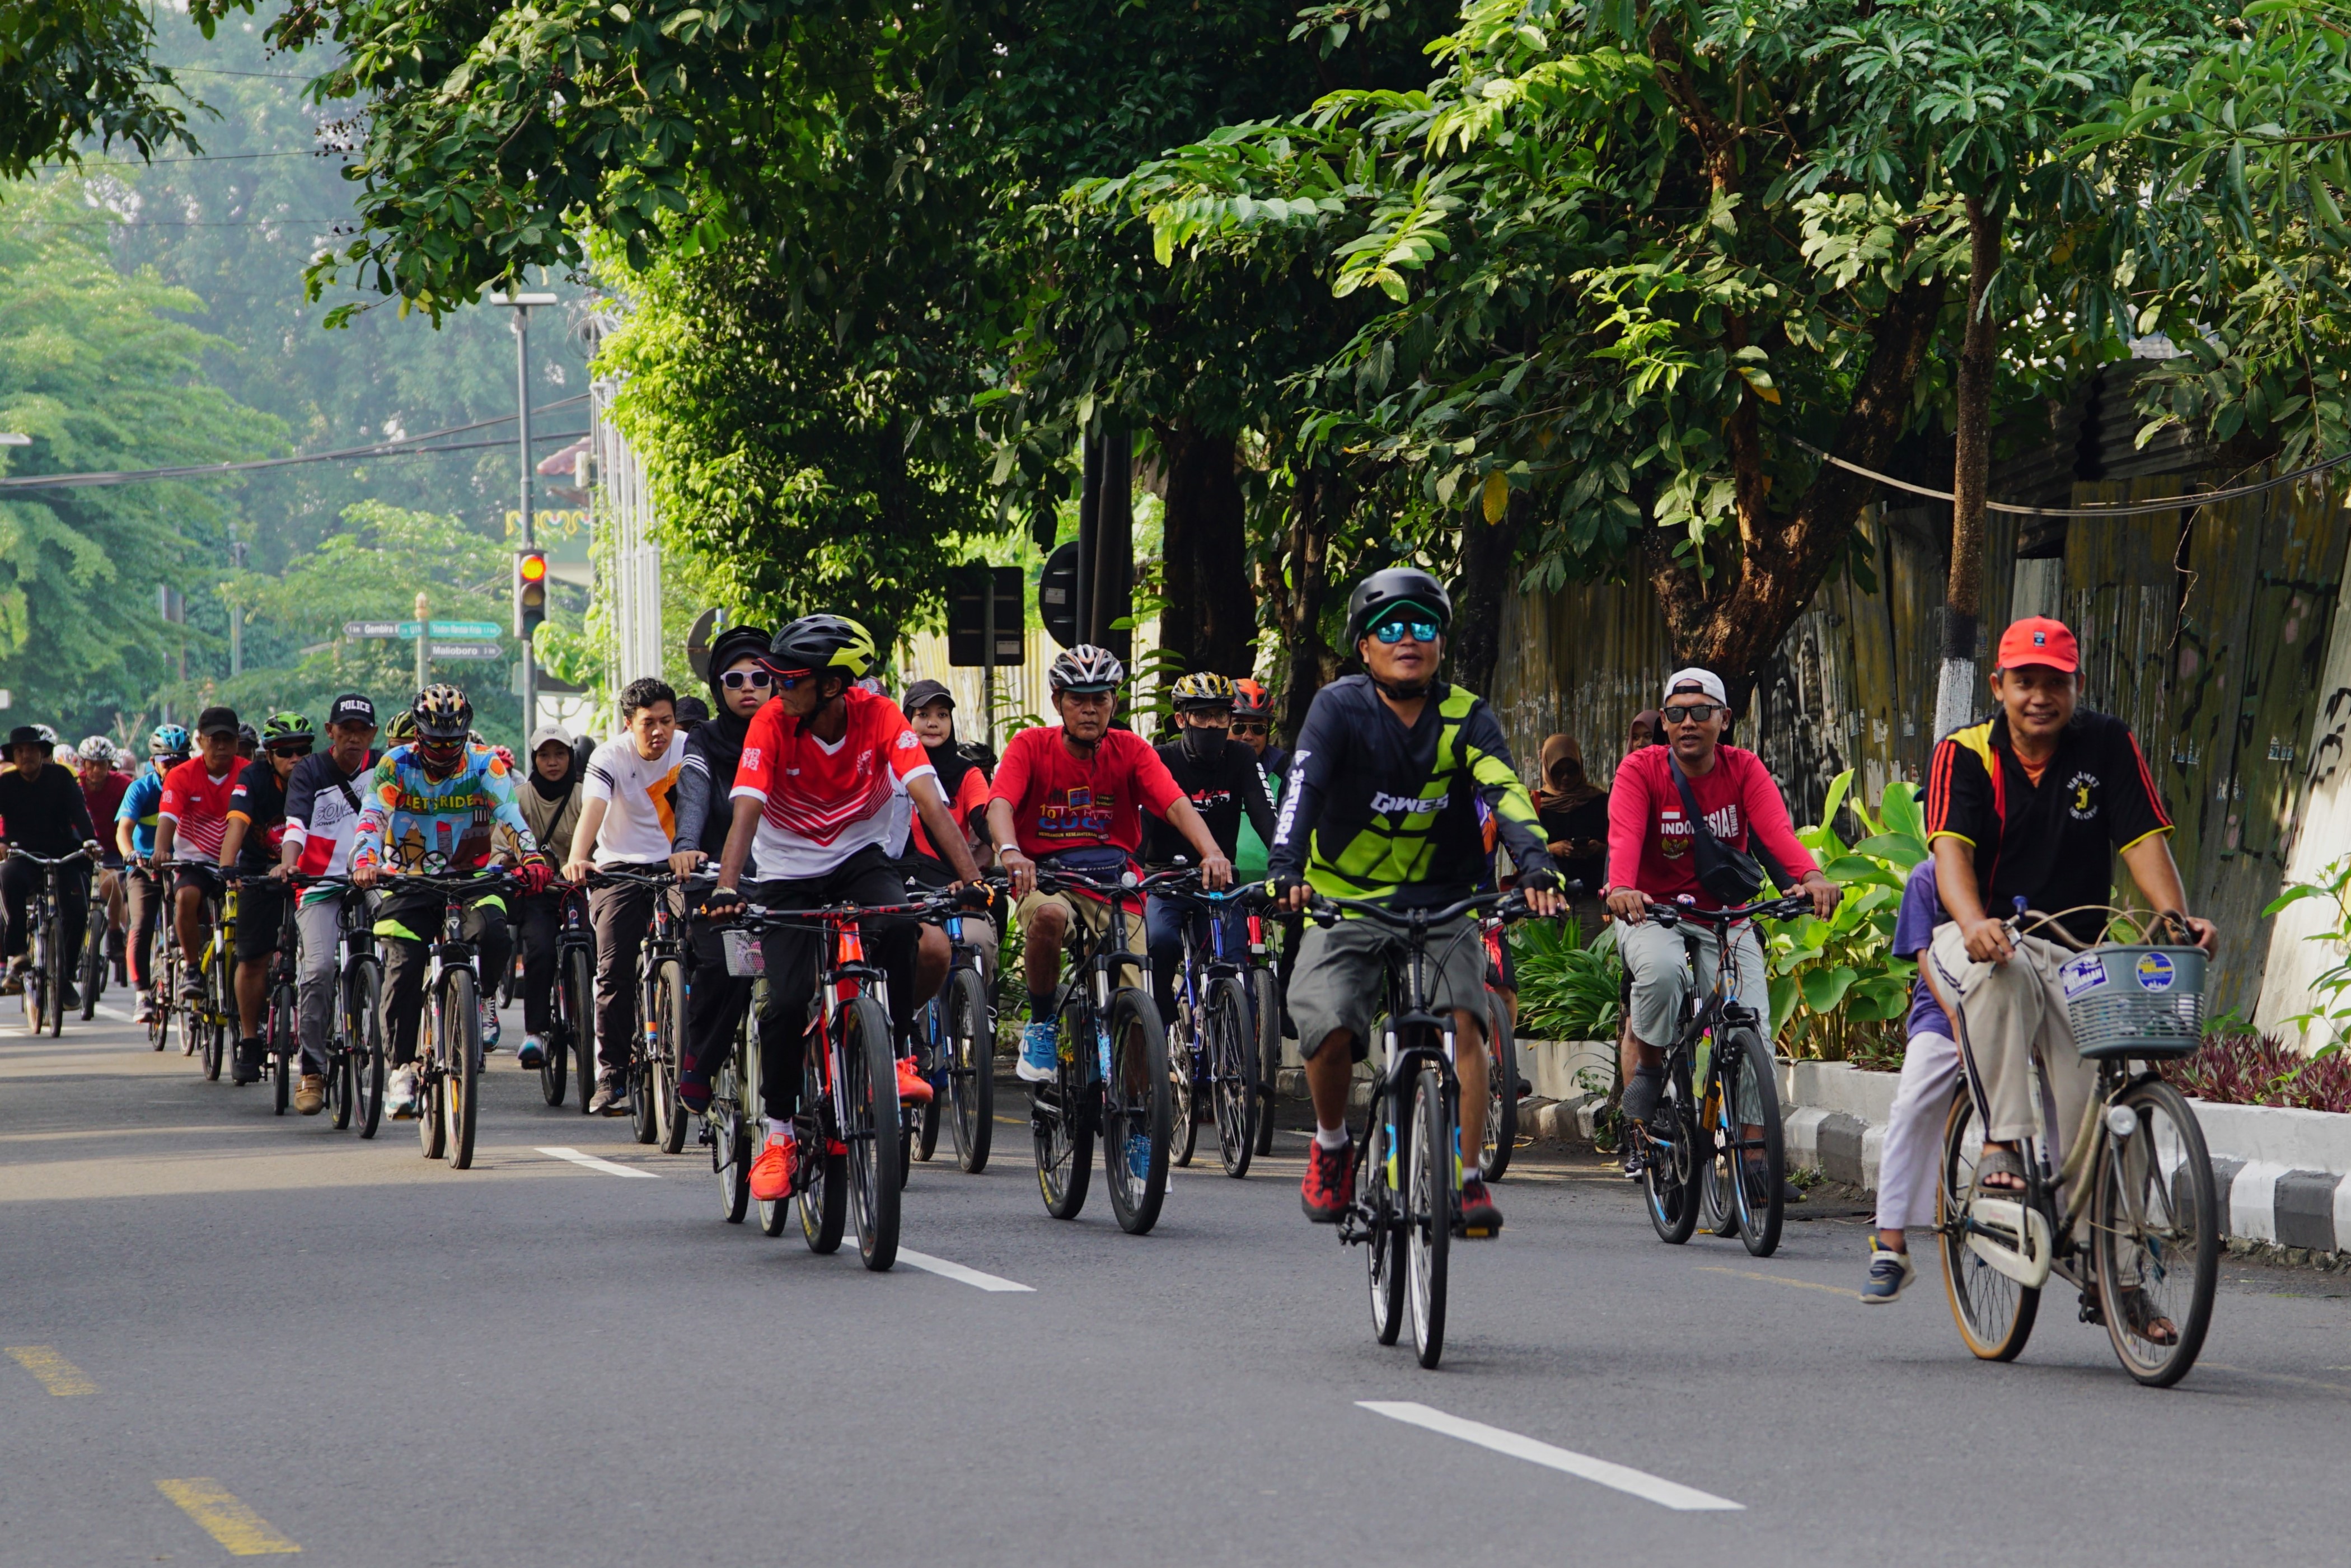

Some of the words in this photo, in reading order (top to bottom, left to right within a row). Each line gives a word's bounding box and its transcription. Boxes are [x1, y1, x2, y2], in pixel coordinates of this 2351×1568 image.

[365, 624, 393, 634] Gembira
[433, 647, 477, 656] Malioboro
[340, 700, 370, 713] POLICE
[440, 794, 474, 808] RIDE
[1039, 803, 1056, 820] 10
[1661, 807, 1732, 838] INDOSIA
[1728, 804, 1739, 837] MERDEKA
